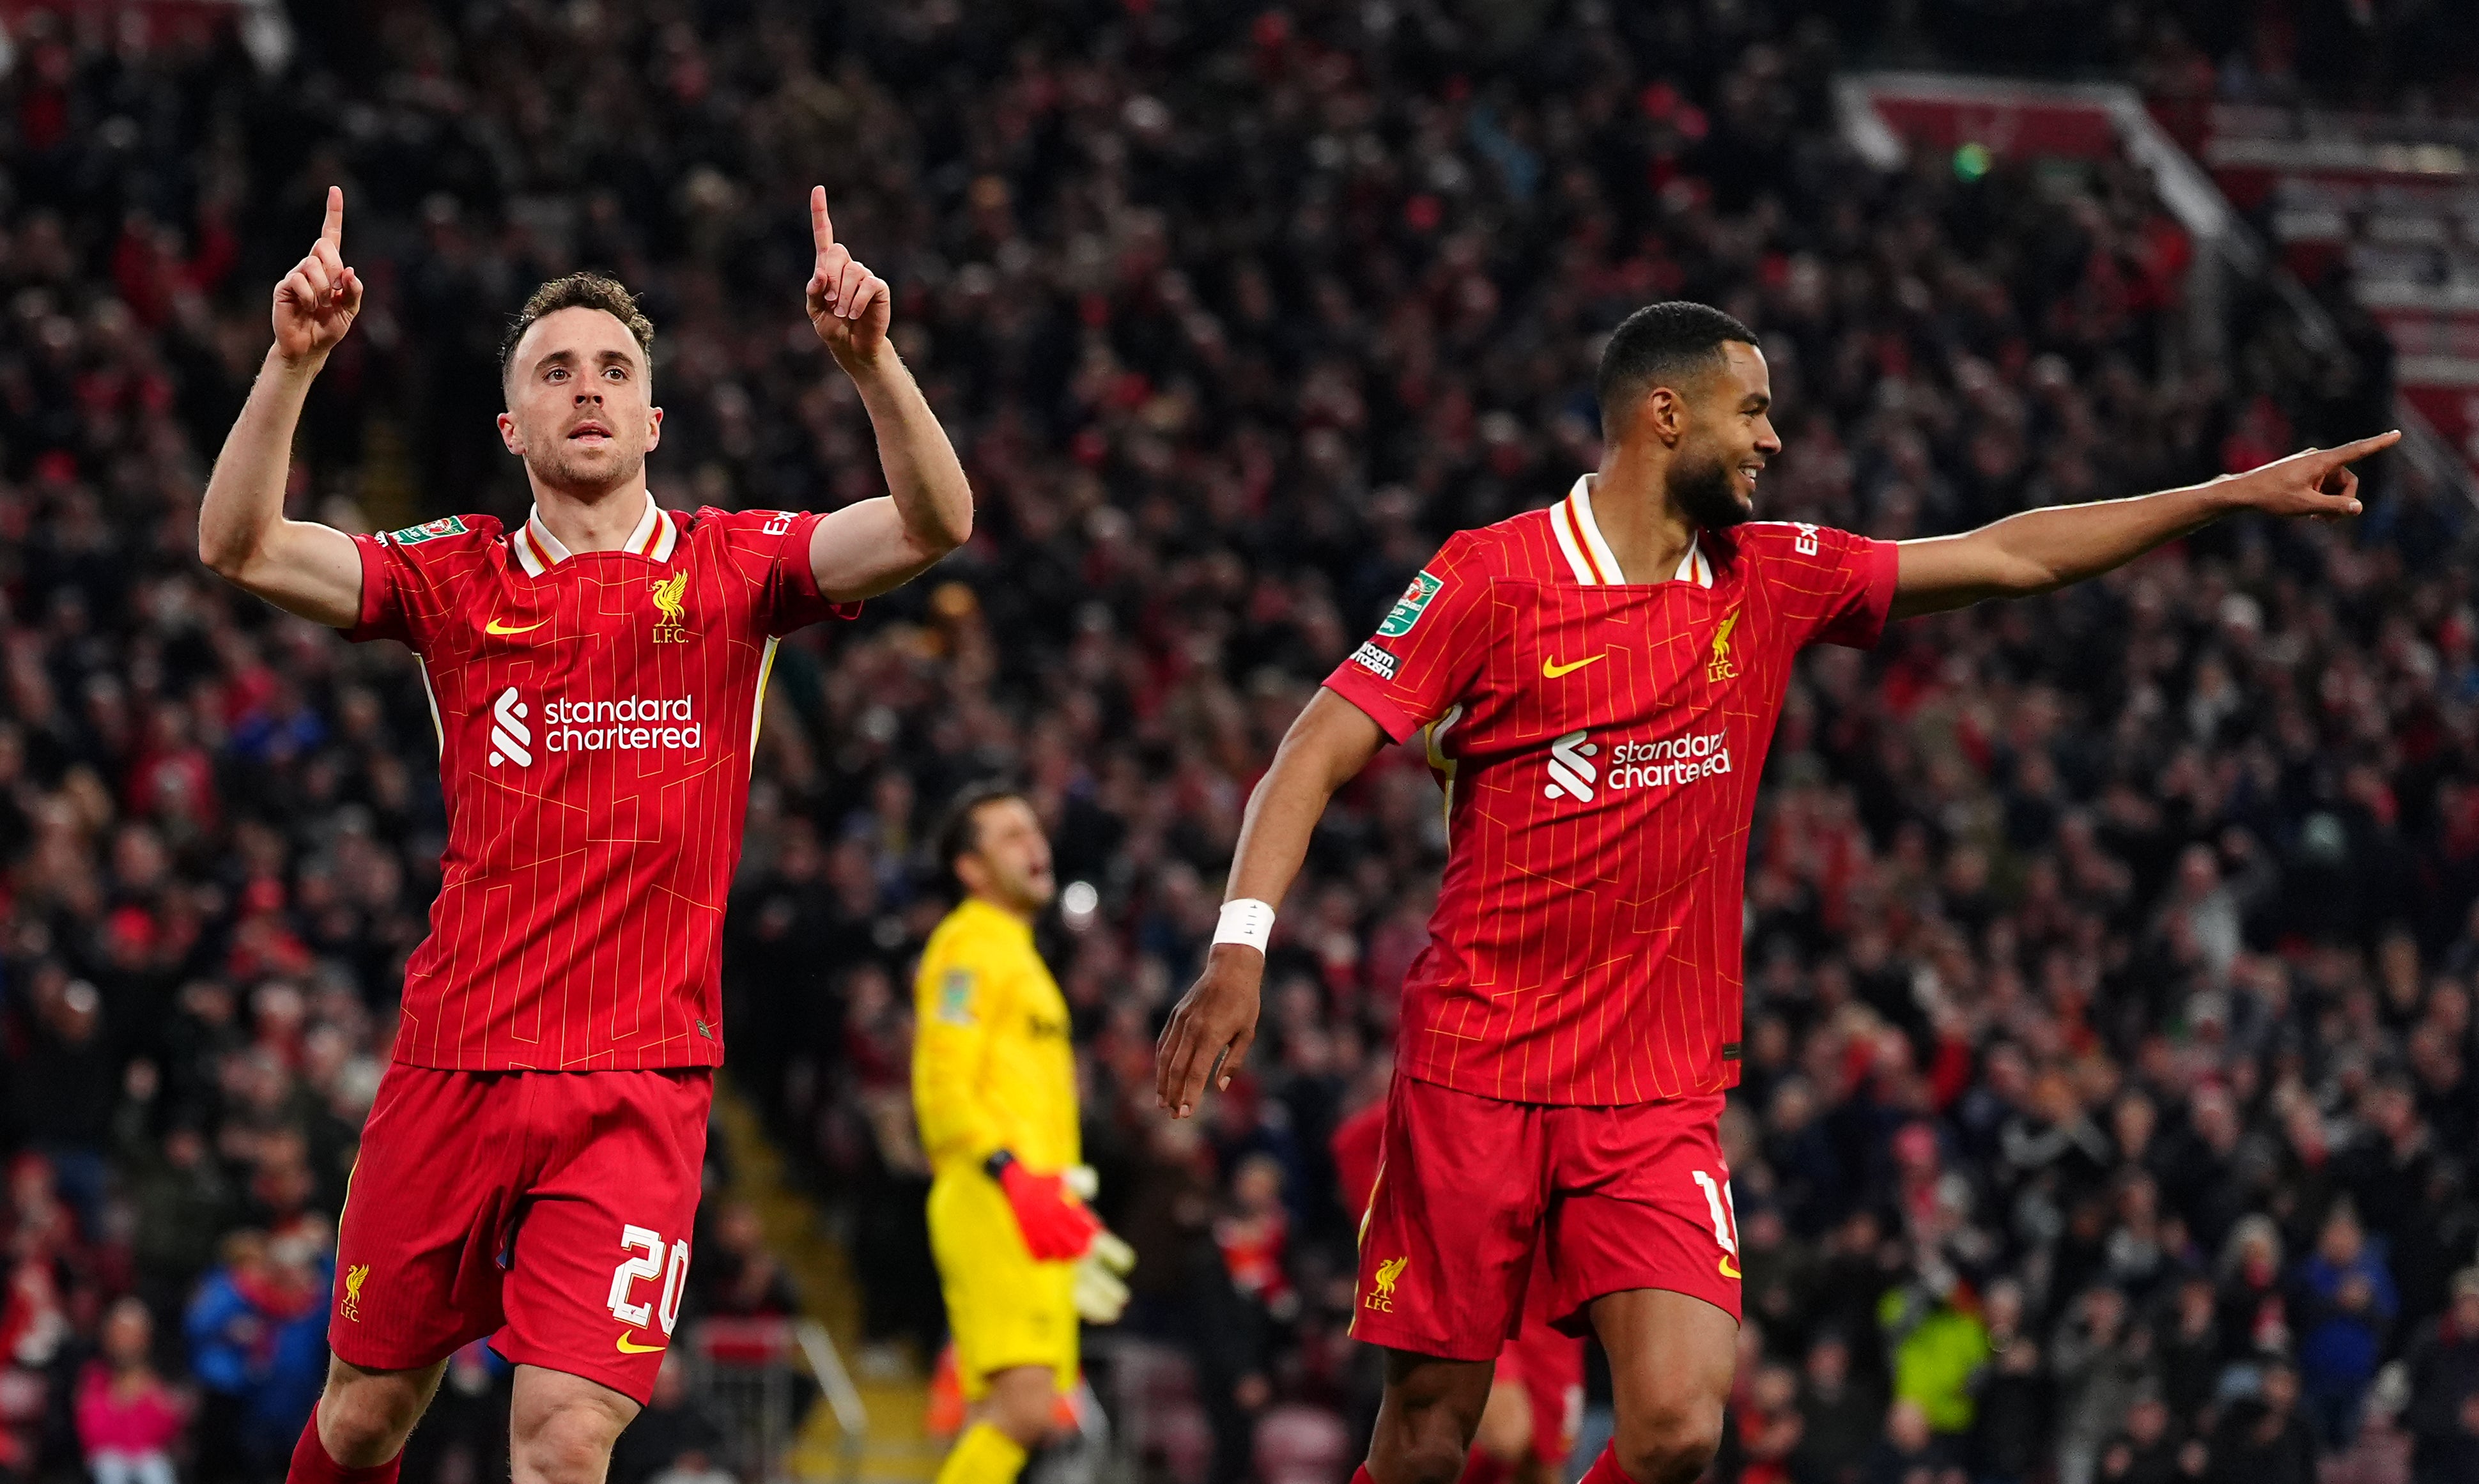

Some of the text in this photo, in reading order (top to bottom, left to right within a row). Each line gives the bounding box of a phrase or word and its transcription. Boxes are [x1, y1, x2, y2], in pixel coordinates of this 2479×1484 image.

[653, 628, 689, 644] L.F.C.
[1363, 644, 1394, 668] room
[544, 694, 692, 725] standard
[546, 722, 701, 753] chartered
[606, 1223, 688, 1338] 20
